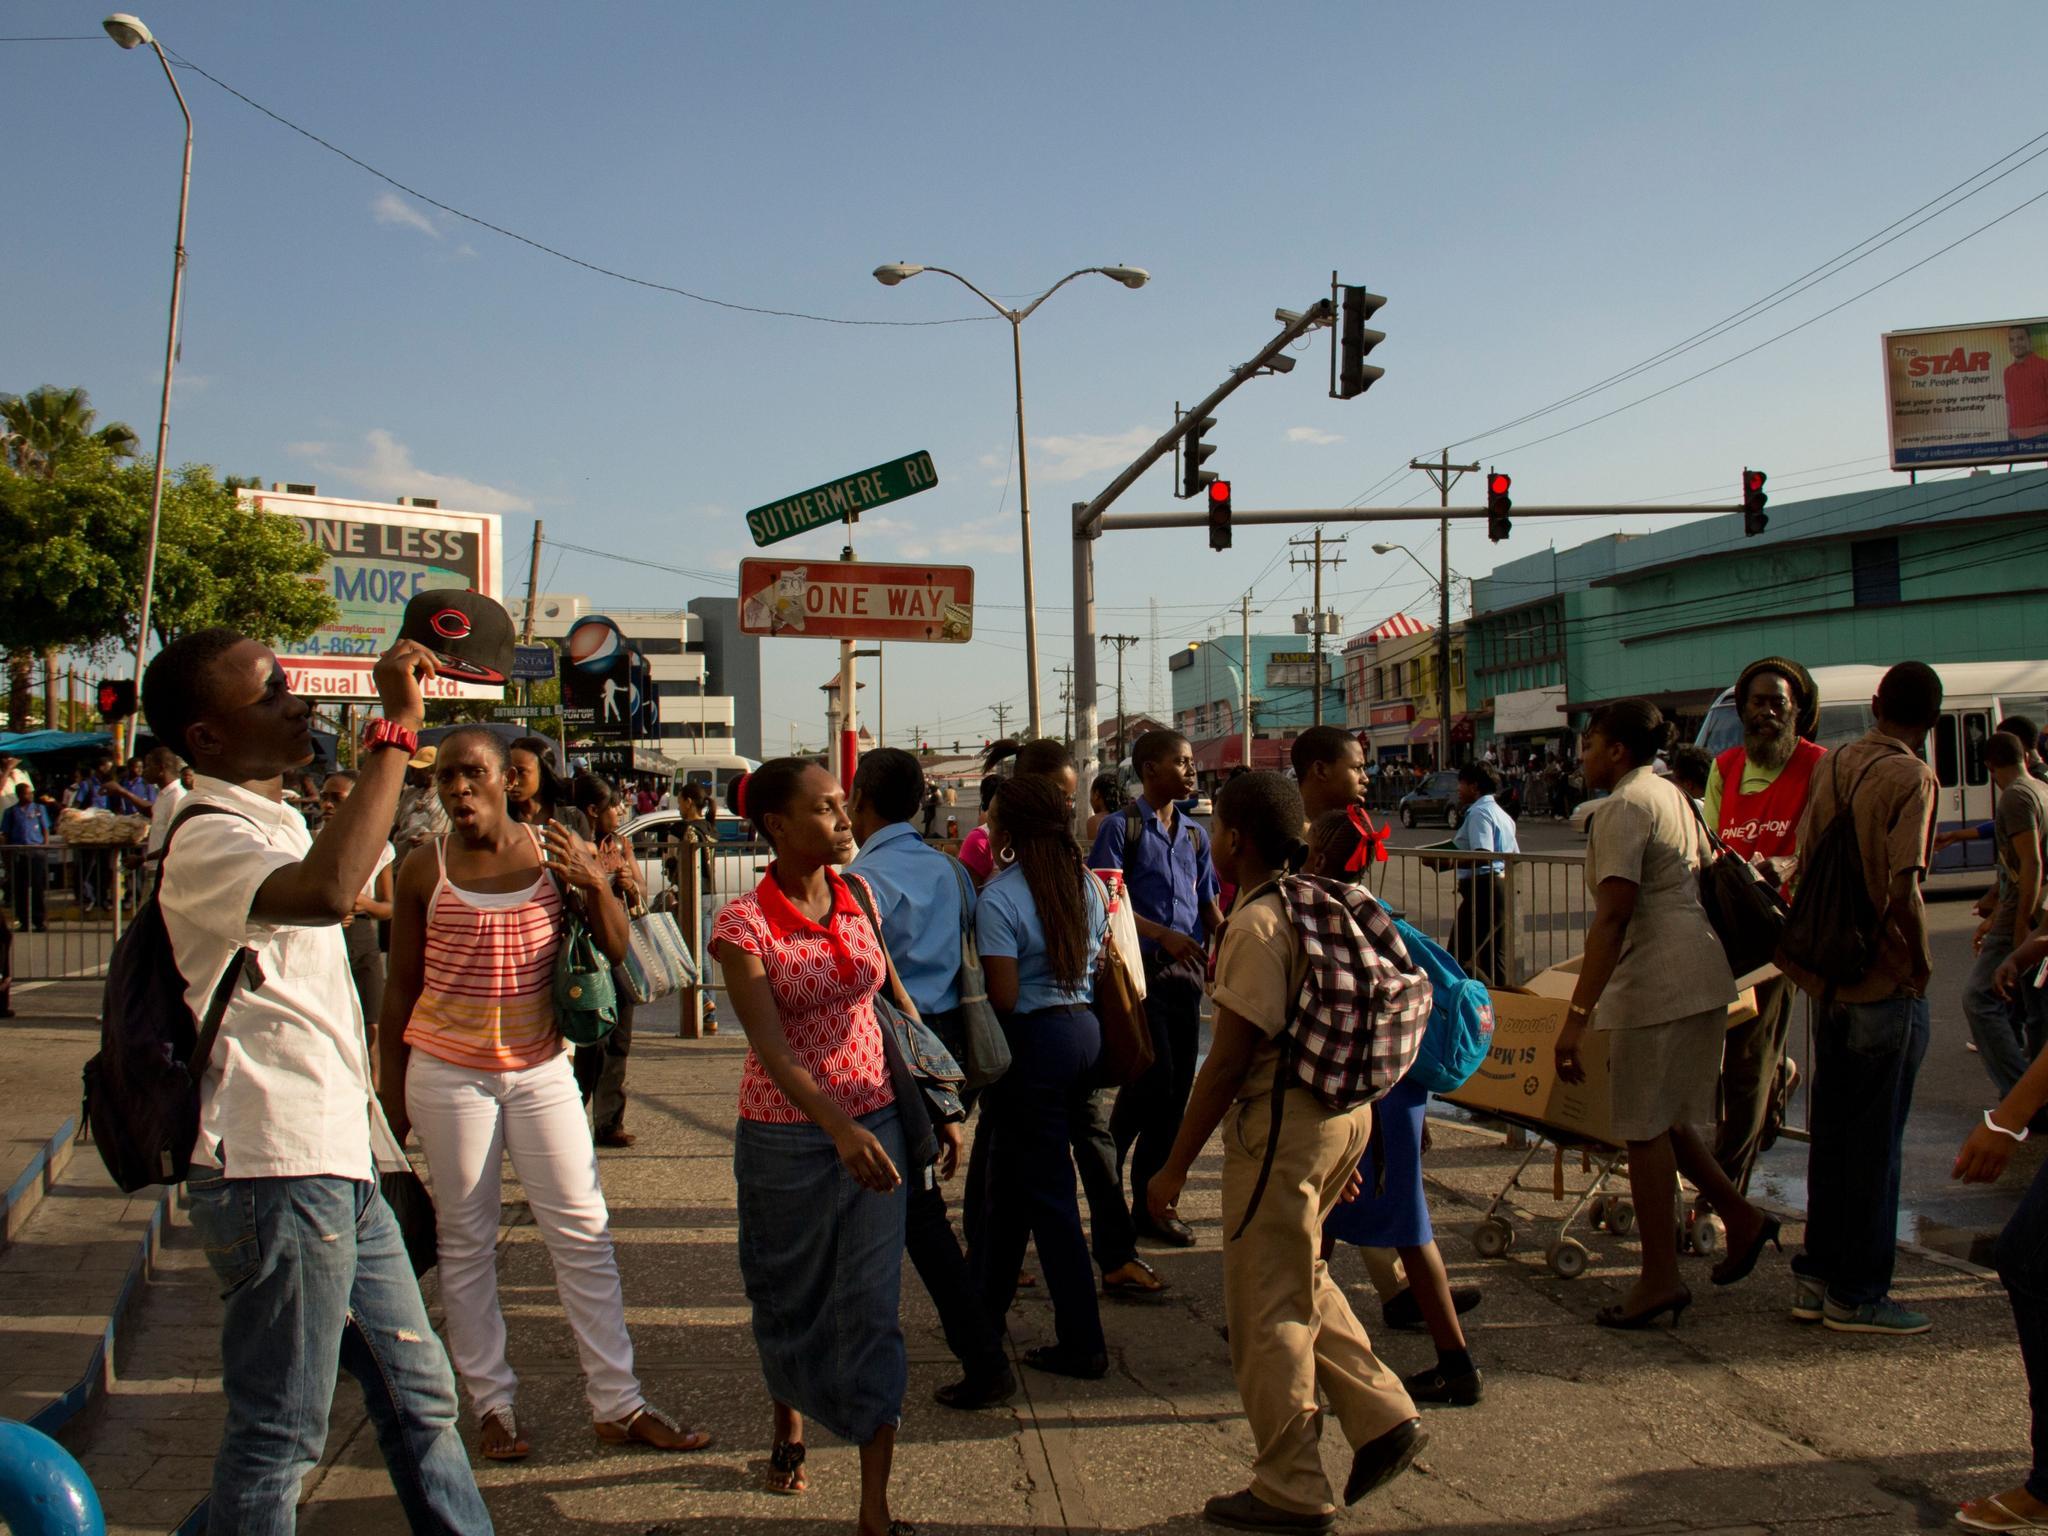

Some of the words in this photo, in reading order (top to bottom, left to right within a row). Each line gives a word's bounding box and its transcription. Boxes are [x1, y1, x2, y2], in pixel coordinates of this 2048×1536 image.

[1907, 346, 1991, 377] STAR
[1911, 379, 1927, 388] The
[1929, 377, 1959, 388] People
[1961, 375, 1990, 385] Paper
[1933, 405, 1943, 413] to
[1945, 403, 1986, 413] Saturday
[1935, 396, 1957, 404] copy
[747, 470, 890, 543] SUTHERMERE
[904, 455, 936, 488] RD
[380, 524, 465, 561] LESS
[333, 565, 428, 605] MORE
[806, 584, 869, 615] ONE
[888, 588, 943, 617] WAY
[513, 655, 551, 665] ENTAL
[286, 670, 358, 695] Visual
[423, 672, 464, 697] Ltd.
[494, 706, 538, 717] SUTHERMERE
[1487, 1046, 1515, 1065] Mar
[1519, 1046, 1536, 1064] St
